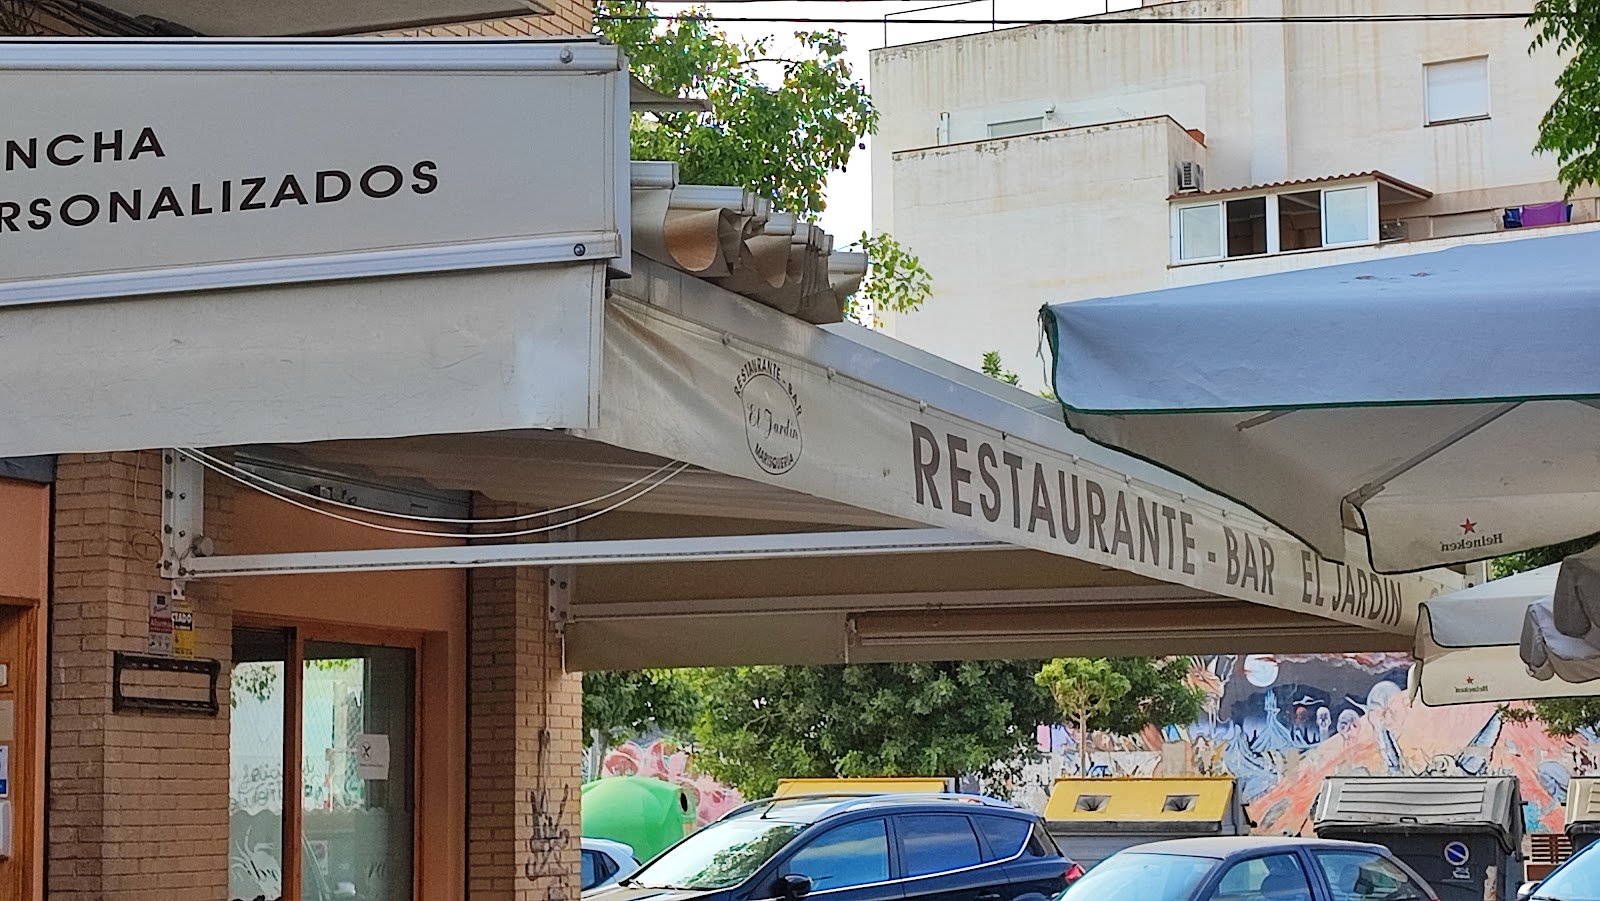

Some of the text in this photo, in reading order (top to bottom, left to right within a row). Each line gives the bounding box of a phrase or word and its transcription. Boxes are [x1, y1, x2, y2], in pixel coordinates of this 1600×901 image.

[5, 127, 166, 171] NCHA
[0, 160, 438, 233] RSONALIZADOS
[734, 358, 781, 399] RESTAURANTE
[788, 382, 802, 416] BAR
[747, 403, 761, 429] El
[910, 421, 1196, 575] RESTAURANTE
[1223, 525, 1275, 595] BAR
[1301, 550, 1325, 607] EL
[1332, 563, 1403, 627] JARDIN
